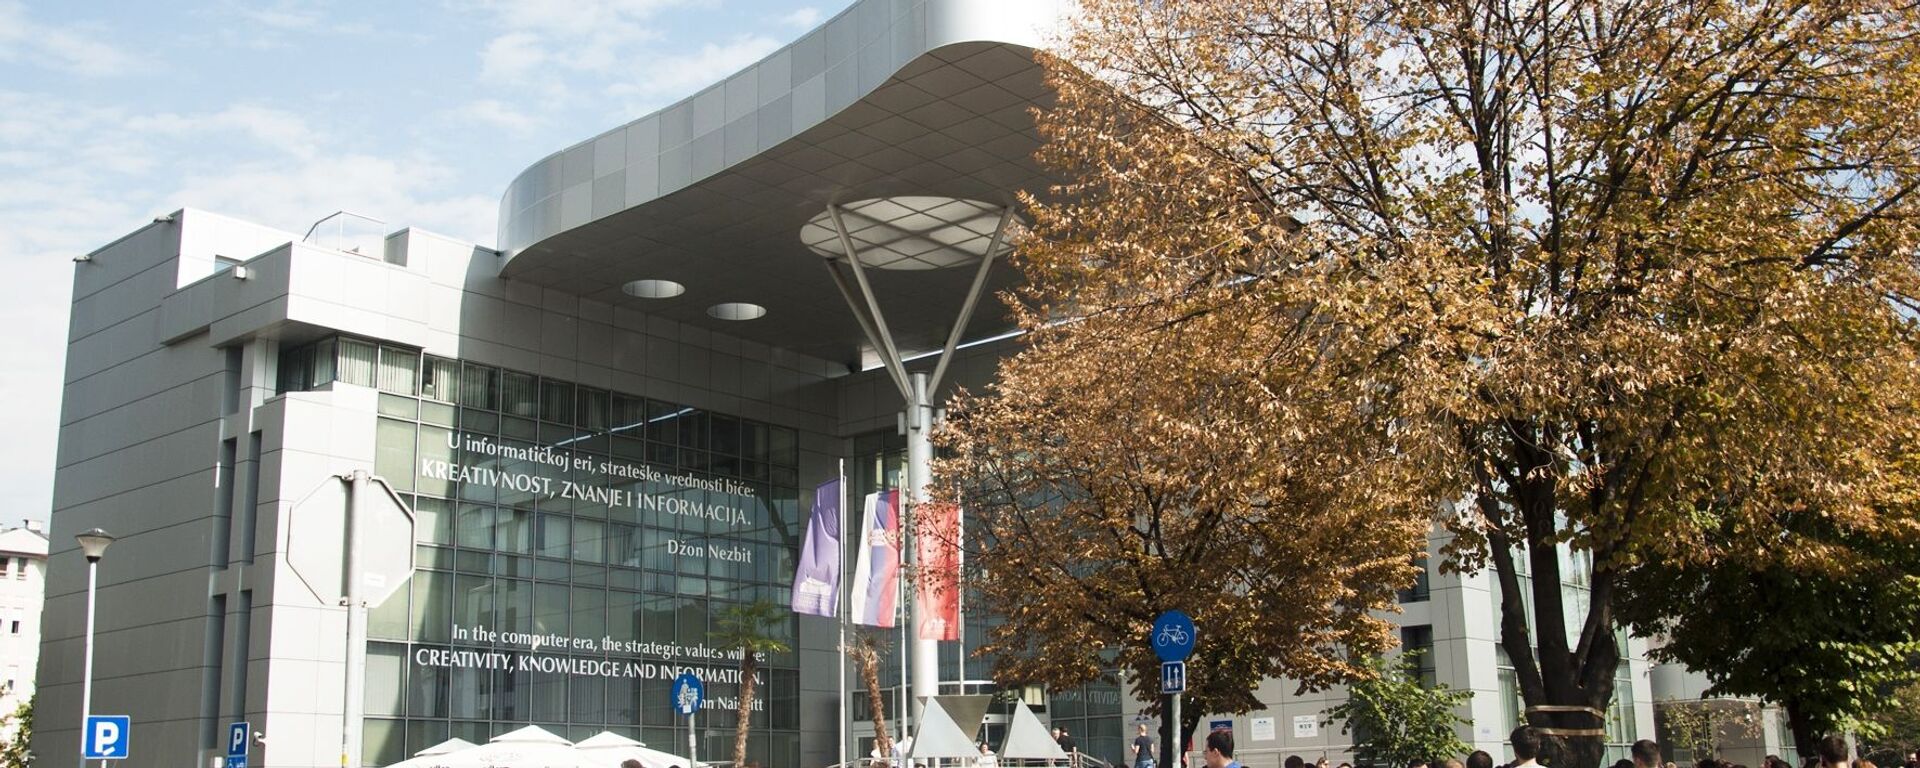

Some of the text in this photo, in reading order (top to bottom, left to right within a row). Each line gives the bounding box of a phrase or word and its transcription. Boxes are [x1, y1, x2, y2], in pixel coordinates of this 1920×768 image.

[447, 432, 755, 498] U informatičkoj eri, strateške vrednosti biće:
[421, 458, 751, 526] KREATIVNOST, ZNANJE I INFORMACIJA.
[667, 539, 752, 563] Džon Nezbit
[453, 624, 467, 640] In
[472, 625, 497, 642] the
[501, 631, 570, 650] computer
[573, 637, 597, 652] era,
[602, 635, 622, 651] the
[625, 640, 682, 660] strategic
[727, 646, 745, 661] will
[416, 648, 514, 673] CREATIVITY,
[519, 655, 620, 677] KNOWLEDGE
[623, 662, 656, 679] AND
[95, 722, 119, 753] P
[232, 728, 243, 751] P
